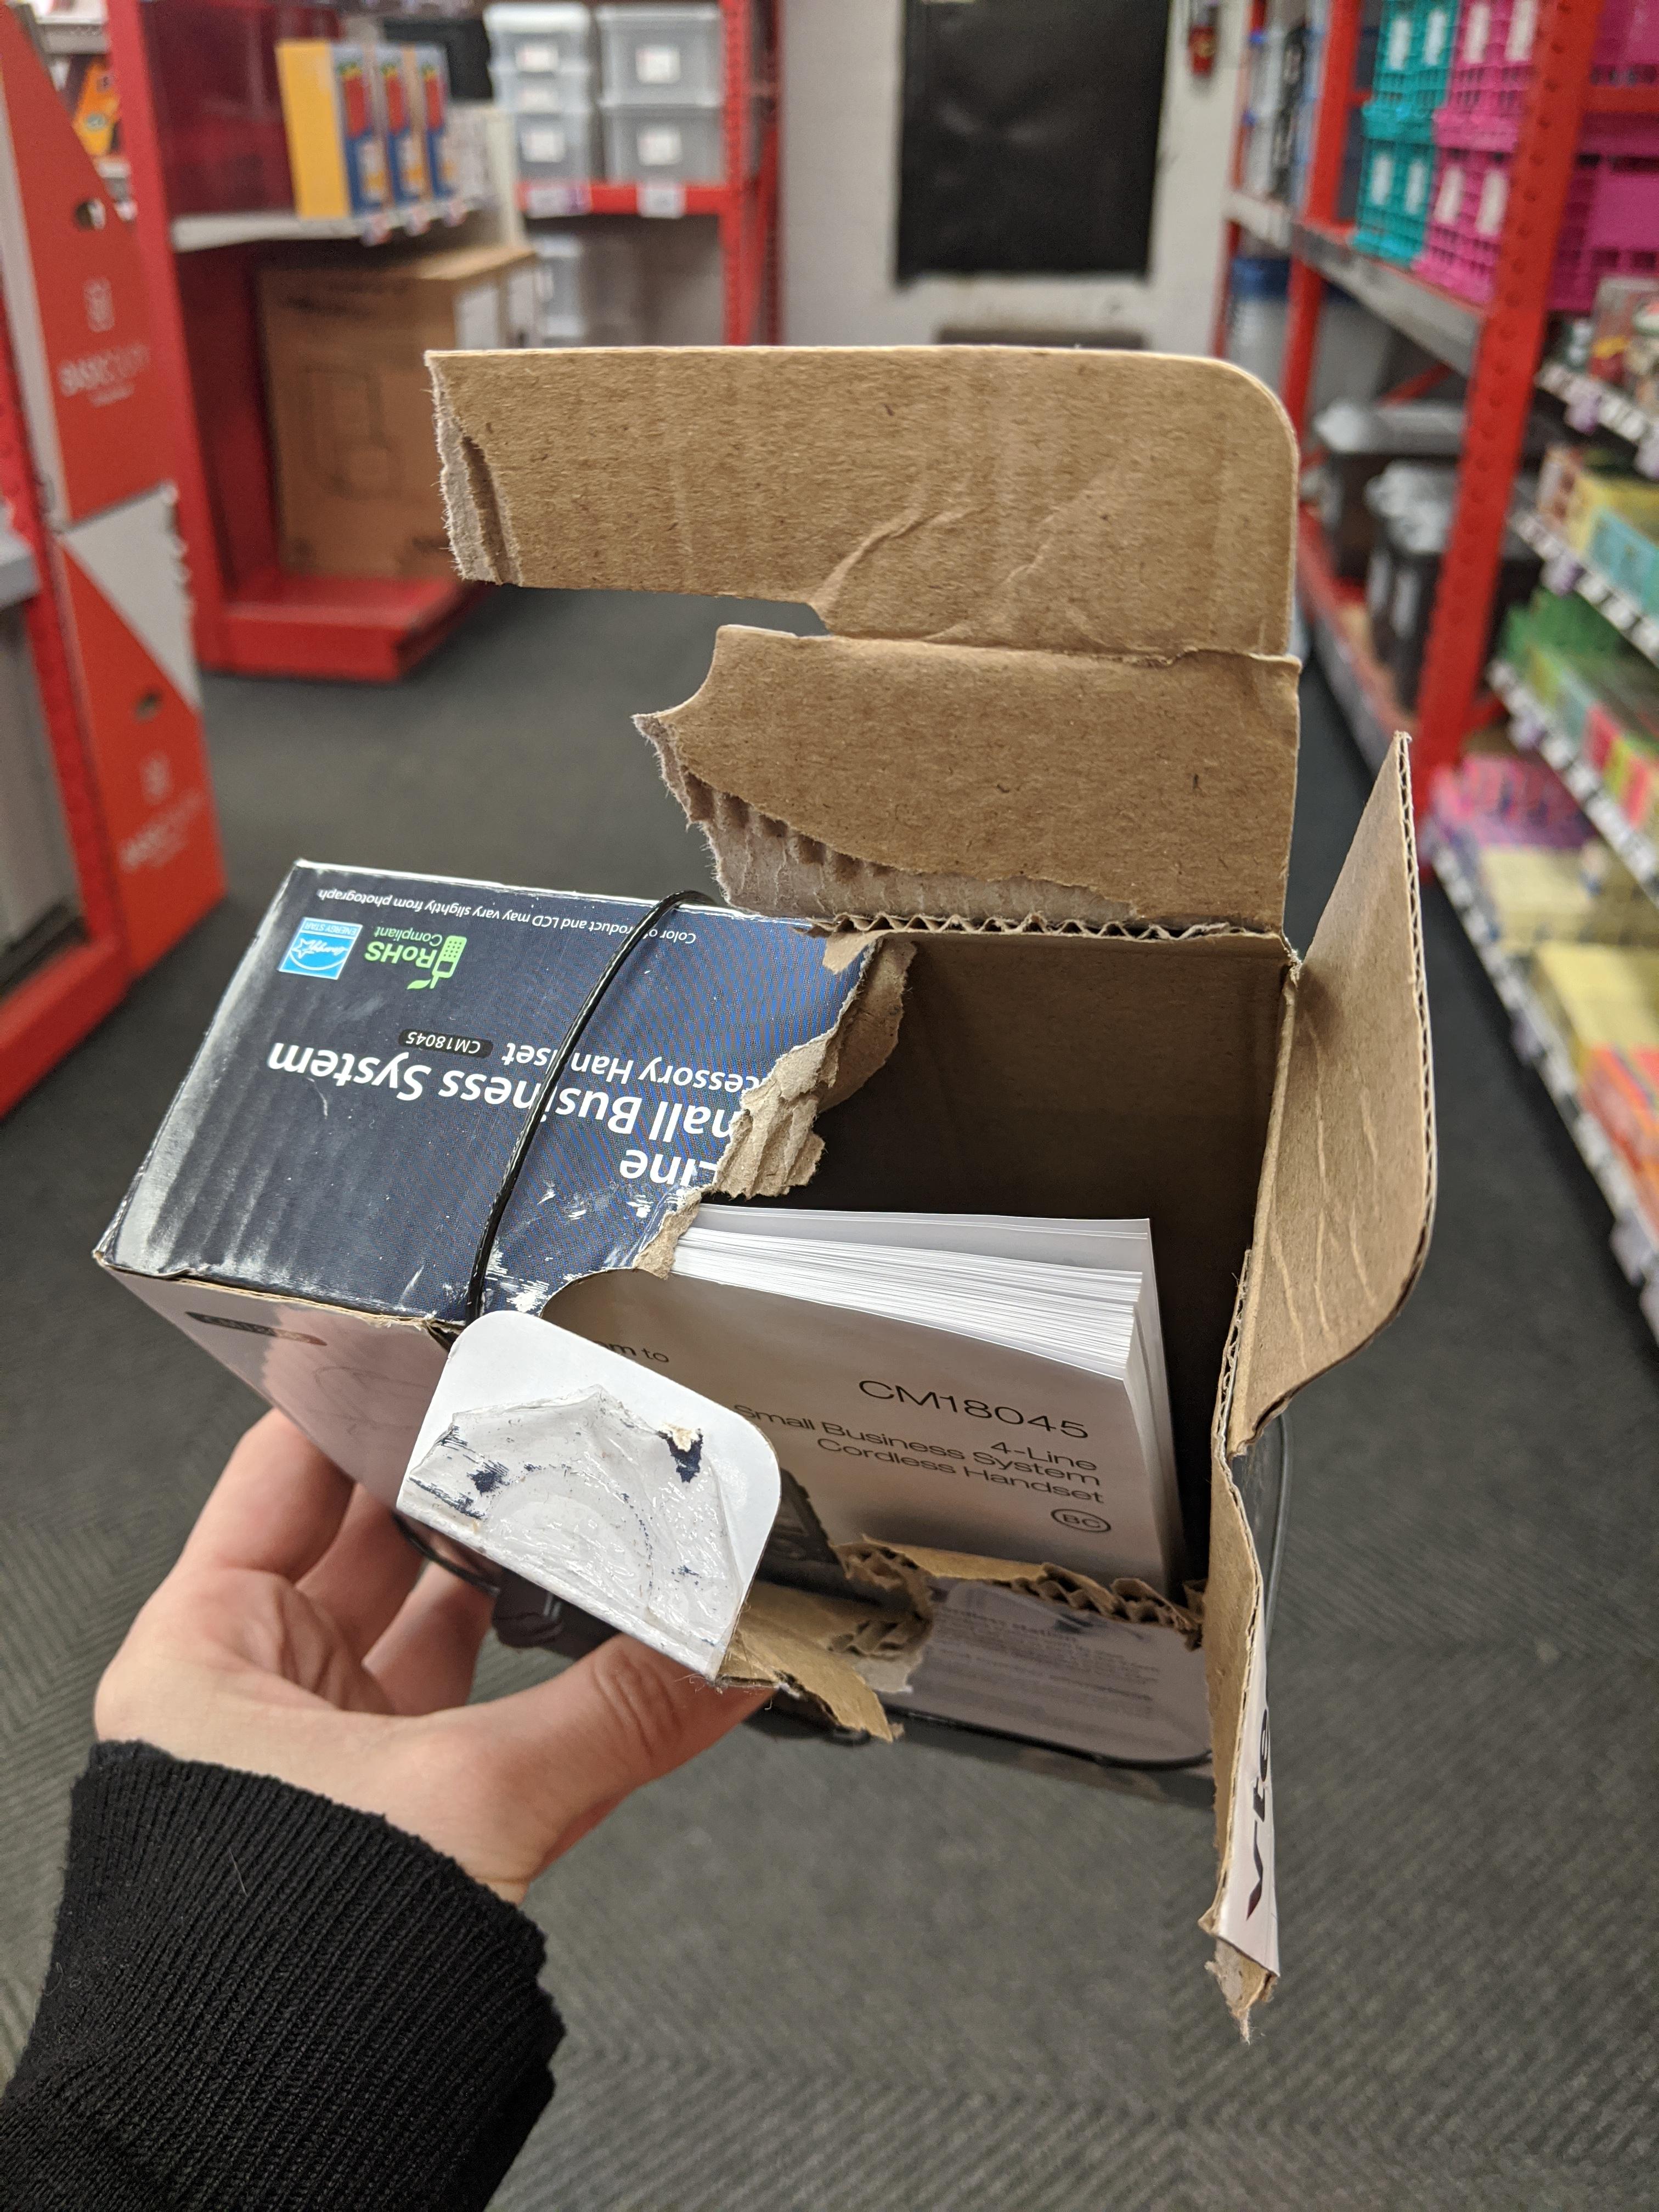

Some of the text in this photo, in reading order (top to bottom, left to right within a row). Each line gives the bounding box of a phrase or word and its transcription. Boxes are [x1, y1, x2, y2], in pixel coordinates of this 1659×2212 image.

[317, 889, 393, 907] photograph
[393, 898, 423, 910] from
[425, 900, 470, 917] slightly
[473, 905, 499, 919] vary
[503, 907, 530, 922] may
[303, 922, 357, 936] ENERGY STAR
[532, 915, 558, 930] LCD
[560, 918, 587, 931] and
[589, 921, 634, 935] roduct
[374, 927, 442, 946] Compliant
[659, 930, 696, 944] Color
[364, 941, 437, 968] RoHS
[405, 1031, 481, 1054] CM18045
[267, 1042, 432, 1101] System
[641, 1348, 669, 1362] to
[859, 1380, 1088, 1438] CM18045
[733, 1404, 1101, 1487] Small Business System
[991, 1442, 1097, 1471] 4-Line
[817, 1438, 1104, 1504] Cordless Handset
